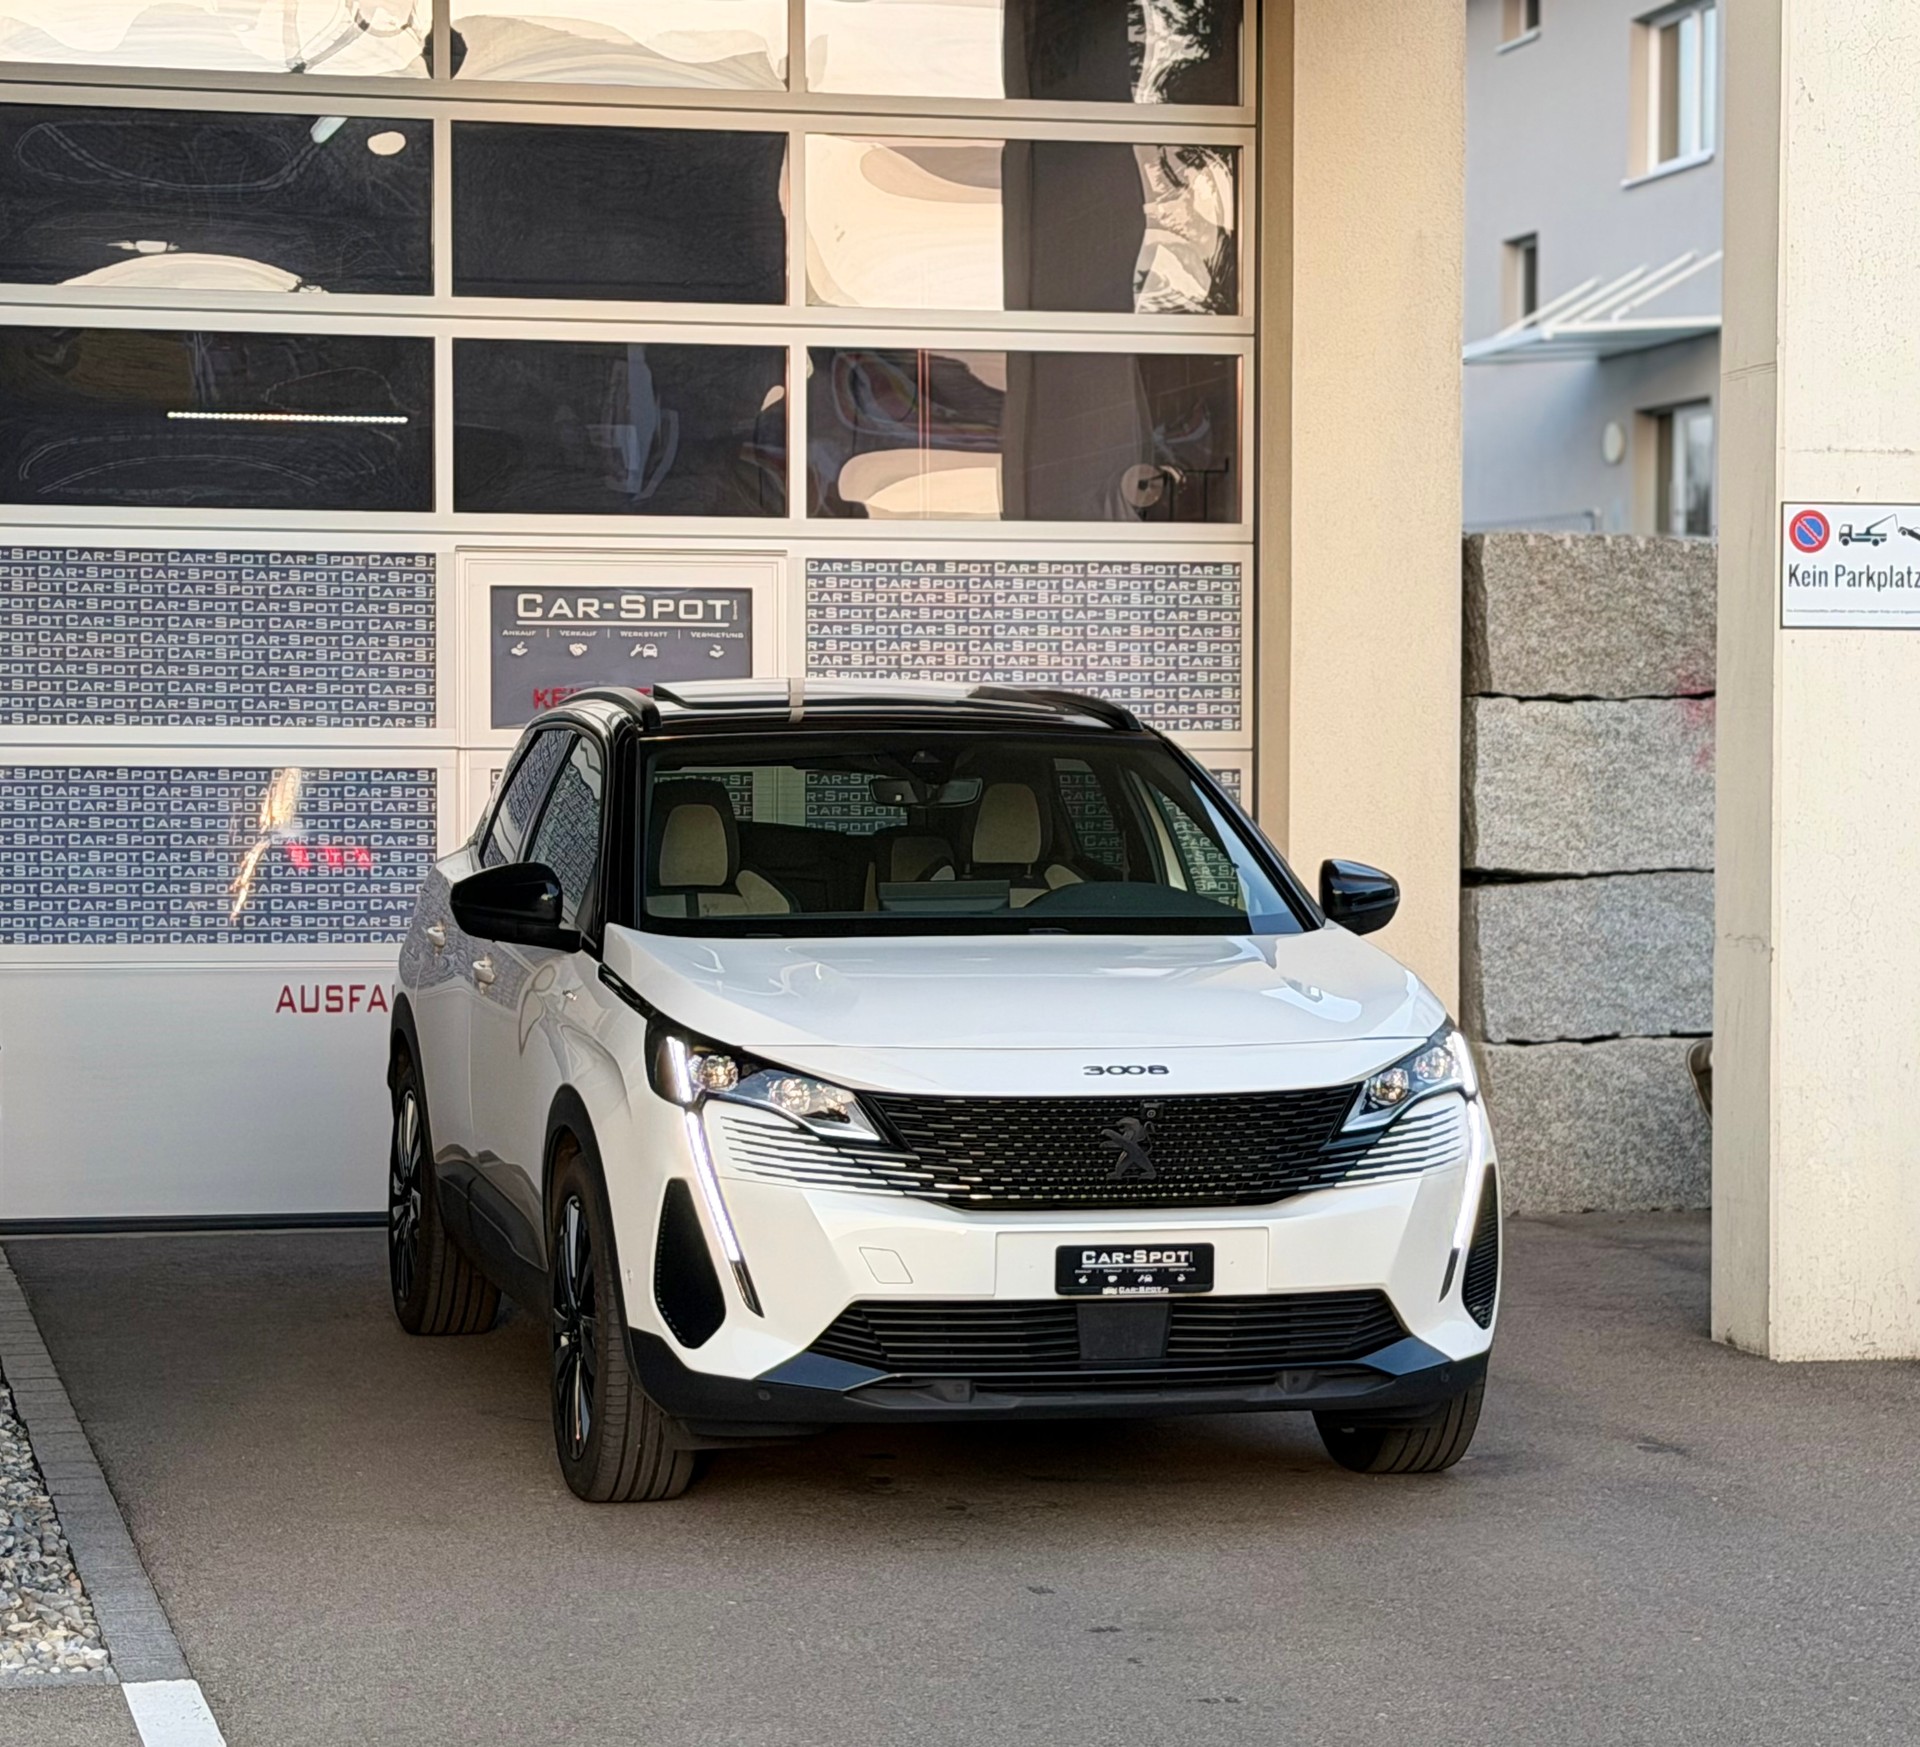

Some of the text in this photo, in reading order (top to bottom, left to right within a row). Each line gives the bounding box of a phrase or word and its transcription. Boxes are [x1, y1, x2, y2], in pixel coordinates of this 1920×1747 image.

[1788, 563, 1920, 592] Kein Parkplatz
[1083, 1065, 1169, 1075] 3008
